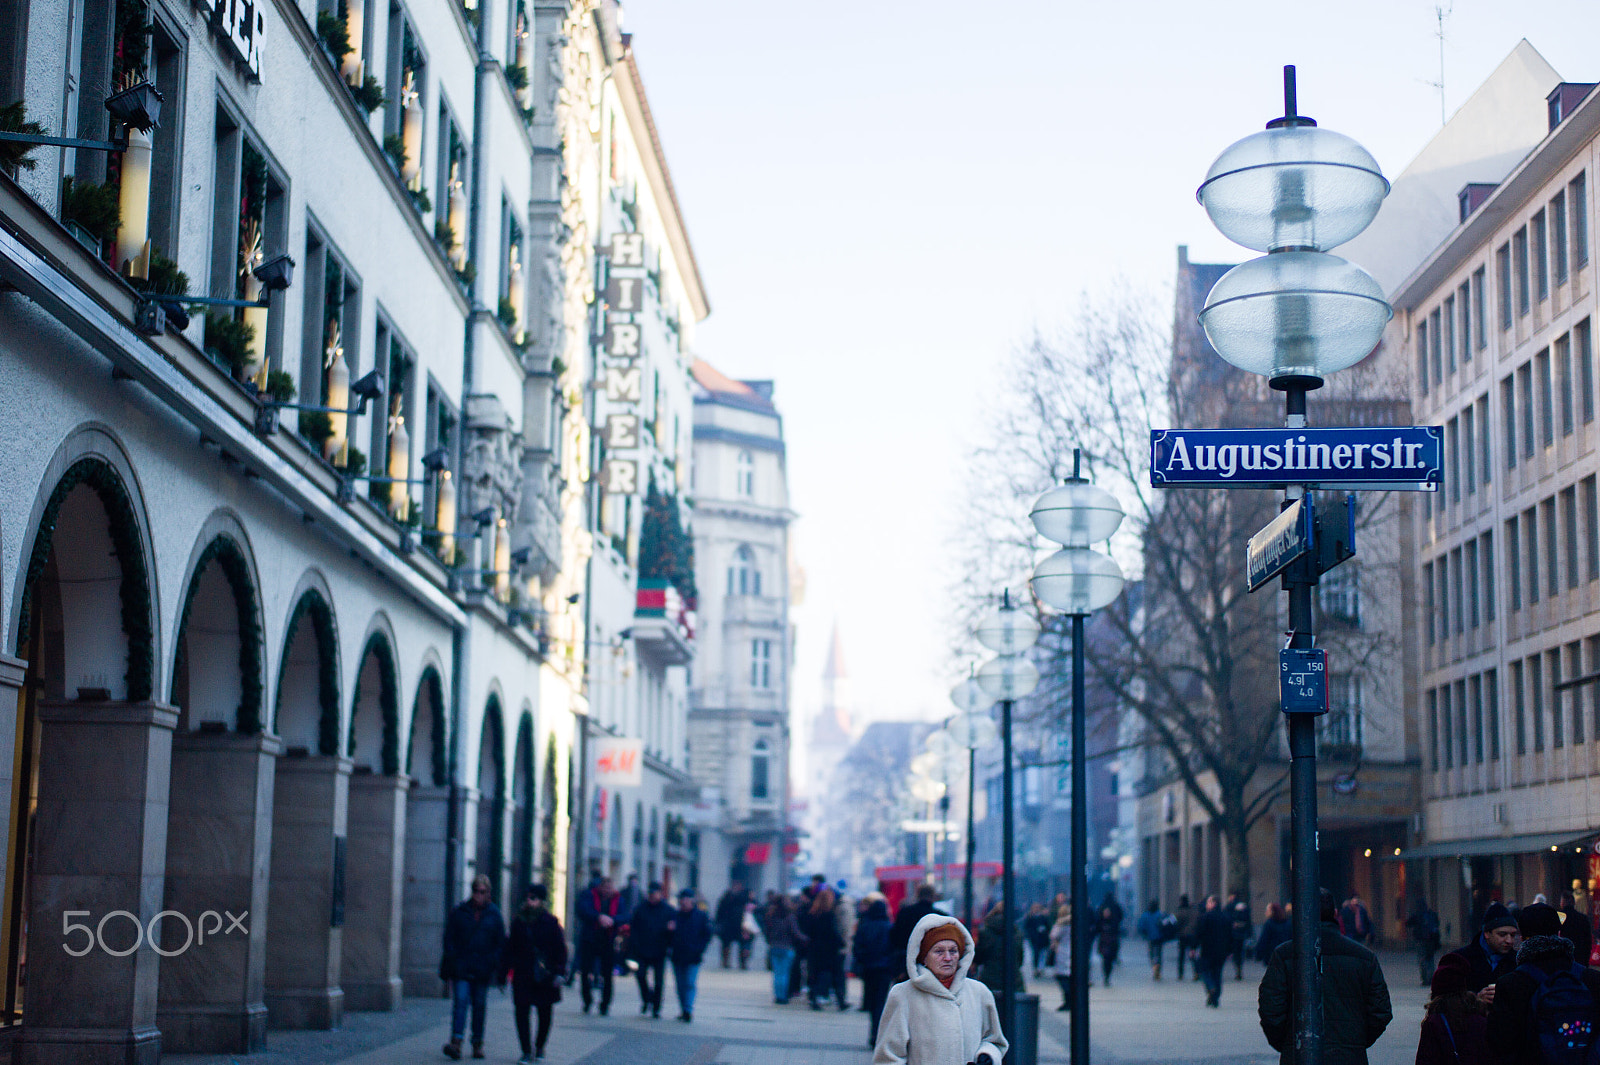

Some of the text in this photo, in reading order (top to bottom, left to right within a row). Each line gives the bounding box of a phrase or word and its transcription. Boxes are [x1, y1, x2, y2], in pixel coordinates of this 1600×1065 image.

[607, 234, 643, 492] HIRMER
[1166, 436, 1426, 477] Augustinerstr.
[1282, 663, 1323, 671] S 150
[1288, 677, 1301, 685] 4.9
[1300, 688, 1313, 696] 4.0
